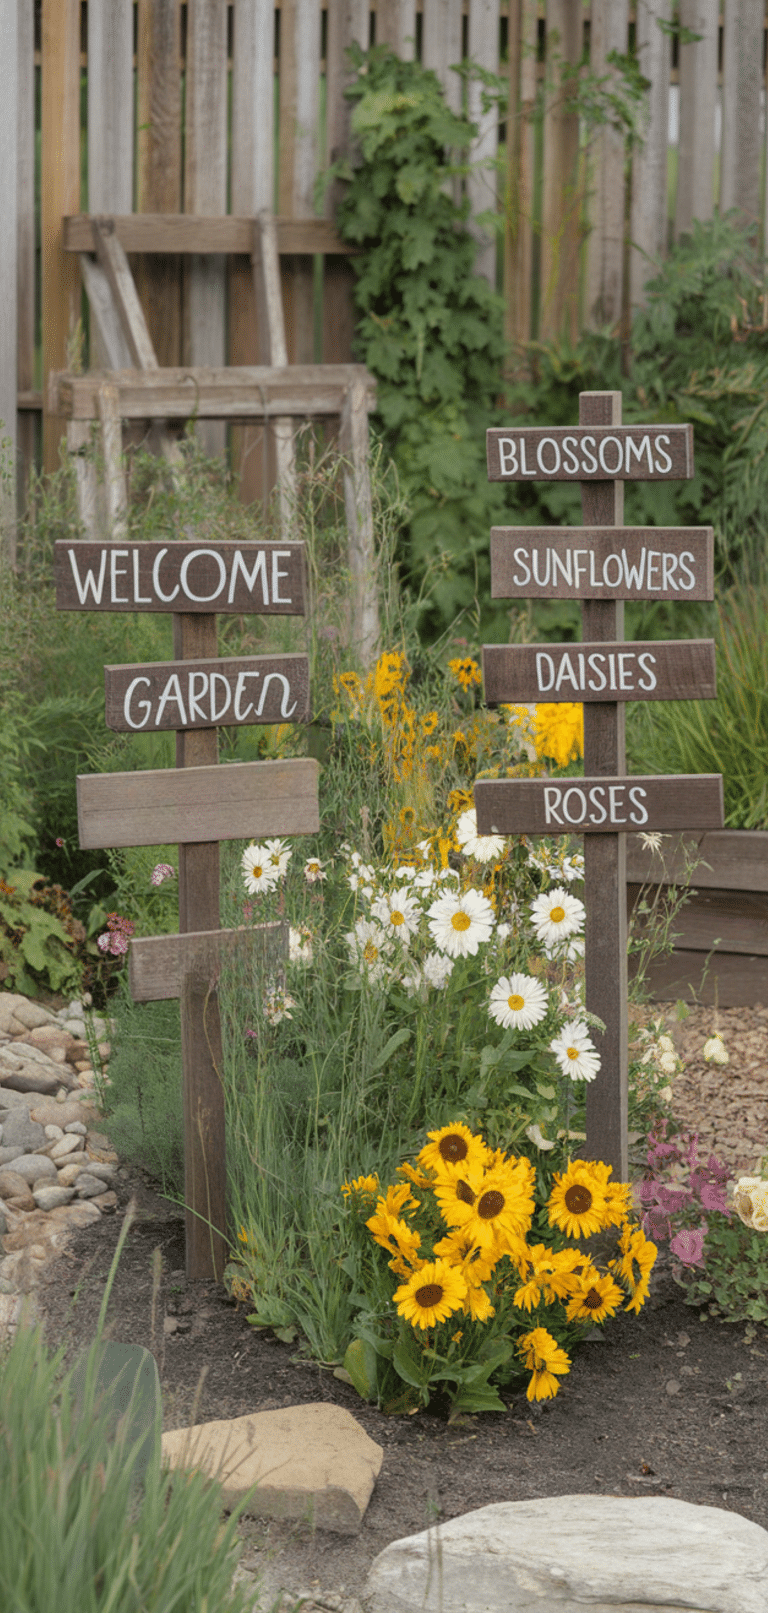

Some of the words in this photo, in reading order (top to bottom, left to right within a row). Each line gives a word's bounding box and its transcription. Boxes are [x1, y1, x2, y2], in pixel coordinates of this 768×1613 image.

[497, 434, 673, 476] BLOSSOMS
[67, 548, 293, 605] WELCOME
[512, 546, 696, 592] SUNFLOWERS
[535, 651, 658, 692] DAISIES
[543, 785, 650, 825] ROSES
